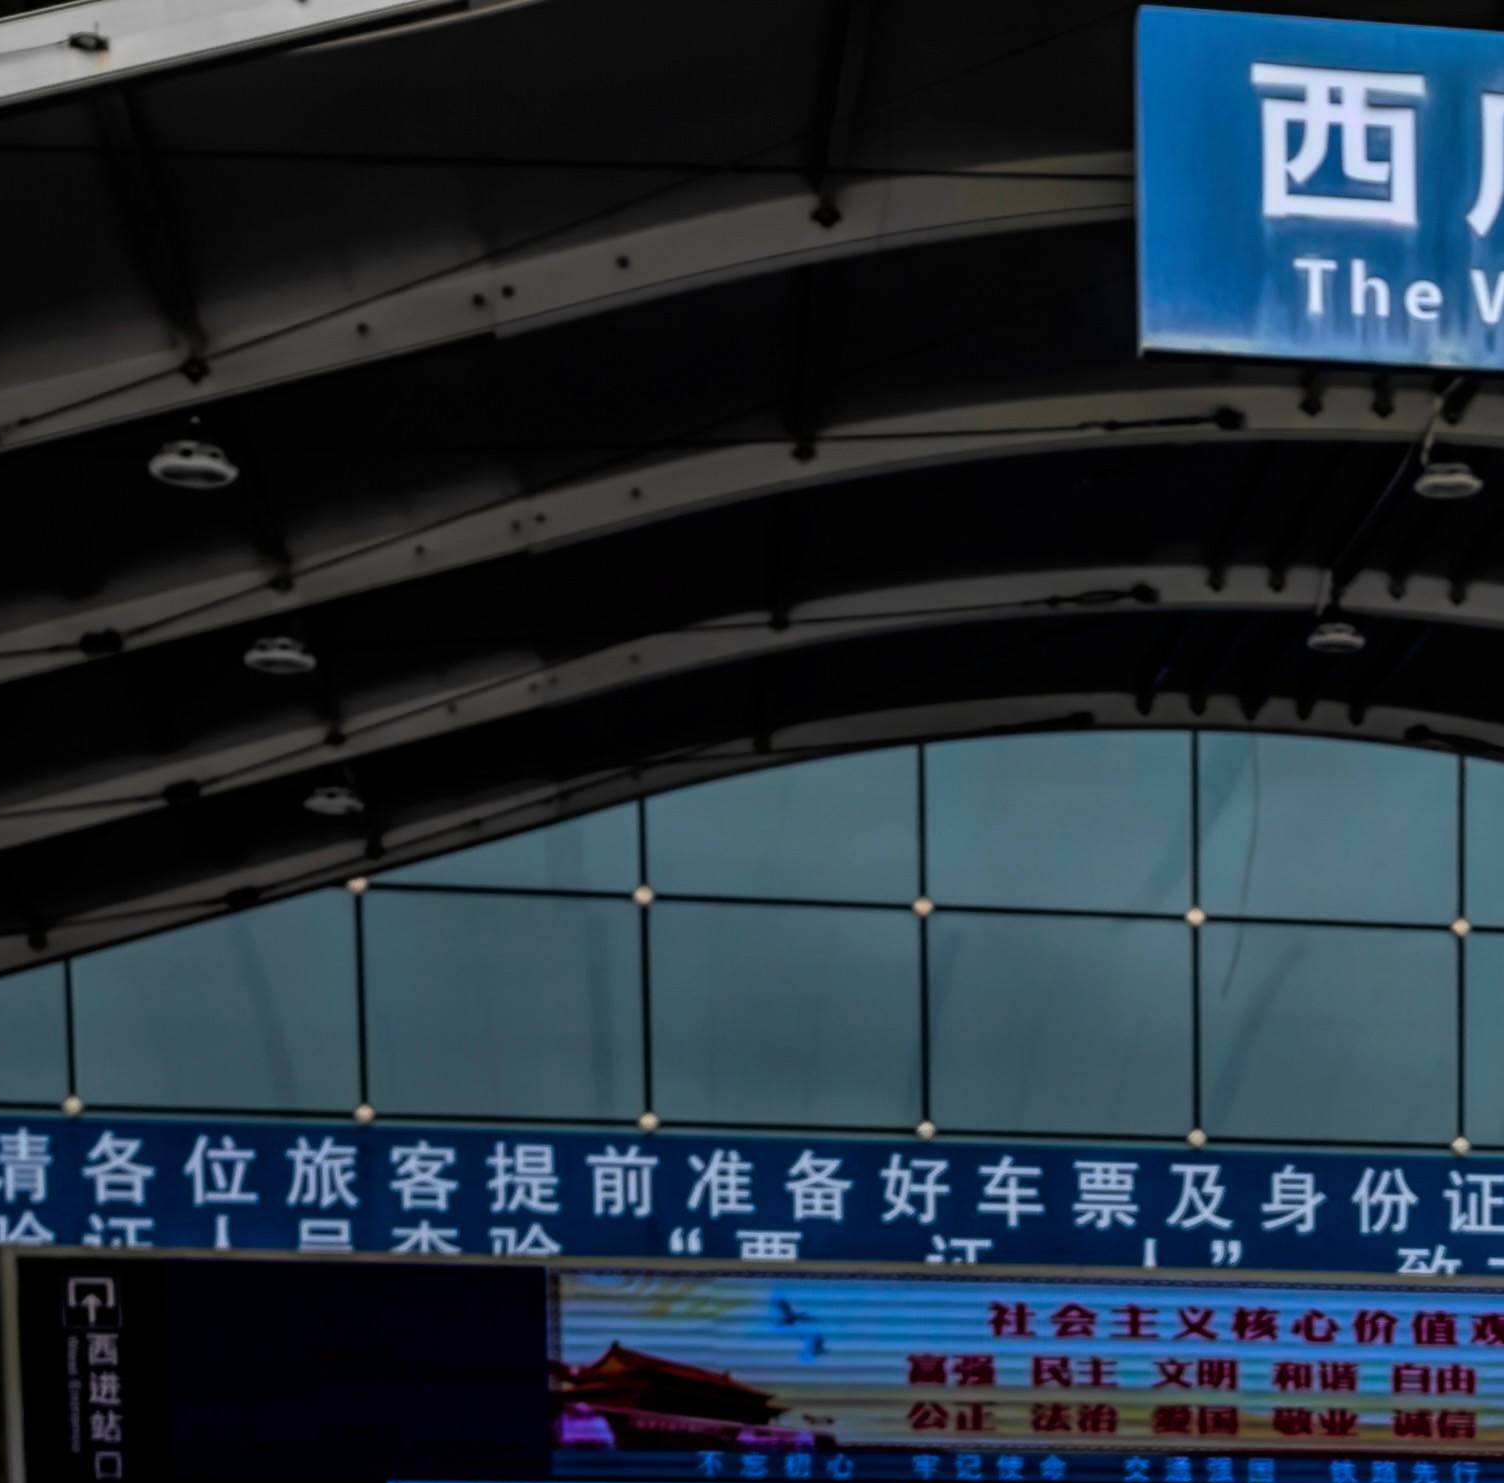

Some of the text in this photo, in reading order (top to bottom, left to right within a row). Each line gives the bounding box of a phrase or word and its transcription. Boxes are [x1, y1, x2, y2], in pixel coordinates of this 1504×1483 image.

[1294, 258, 1443, 323] The
[908, 1354, 995, 1387] 富强
[1032, 1355, 1118, 1388] 民主
[1153, 1357, 1239, 1390] 文明
[1273, 1361, 1358, 1392] 和谐
[1392, 1363, 1476, 1395] 自由
[908, 1400, 995, 1433] 公正
[1032, 1402, 1117, 1434] 法治
[1152, 1405, 1238, 1435] 爱国
[1272, 1407, 1359, 1437] 敬业
[1393, 1409, 1476, 1440] 诚信
